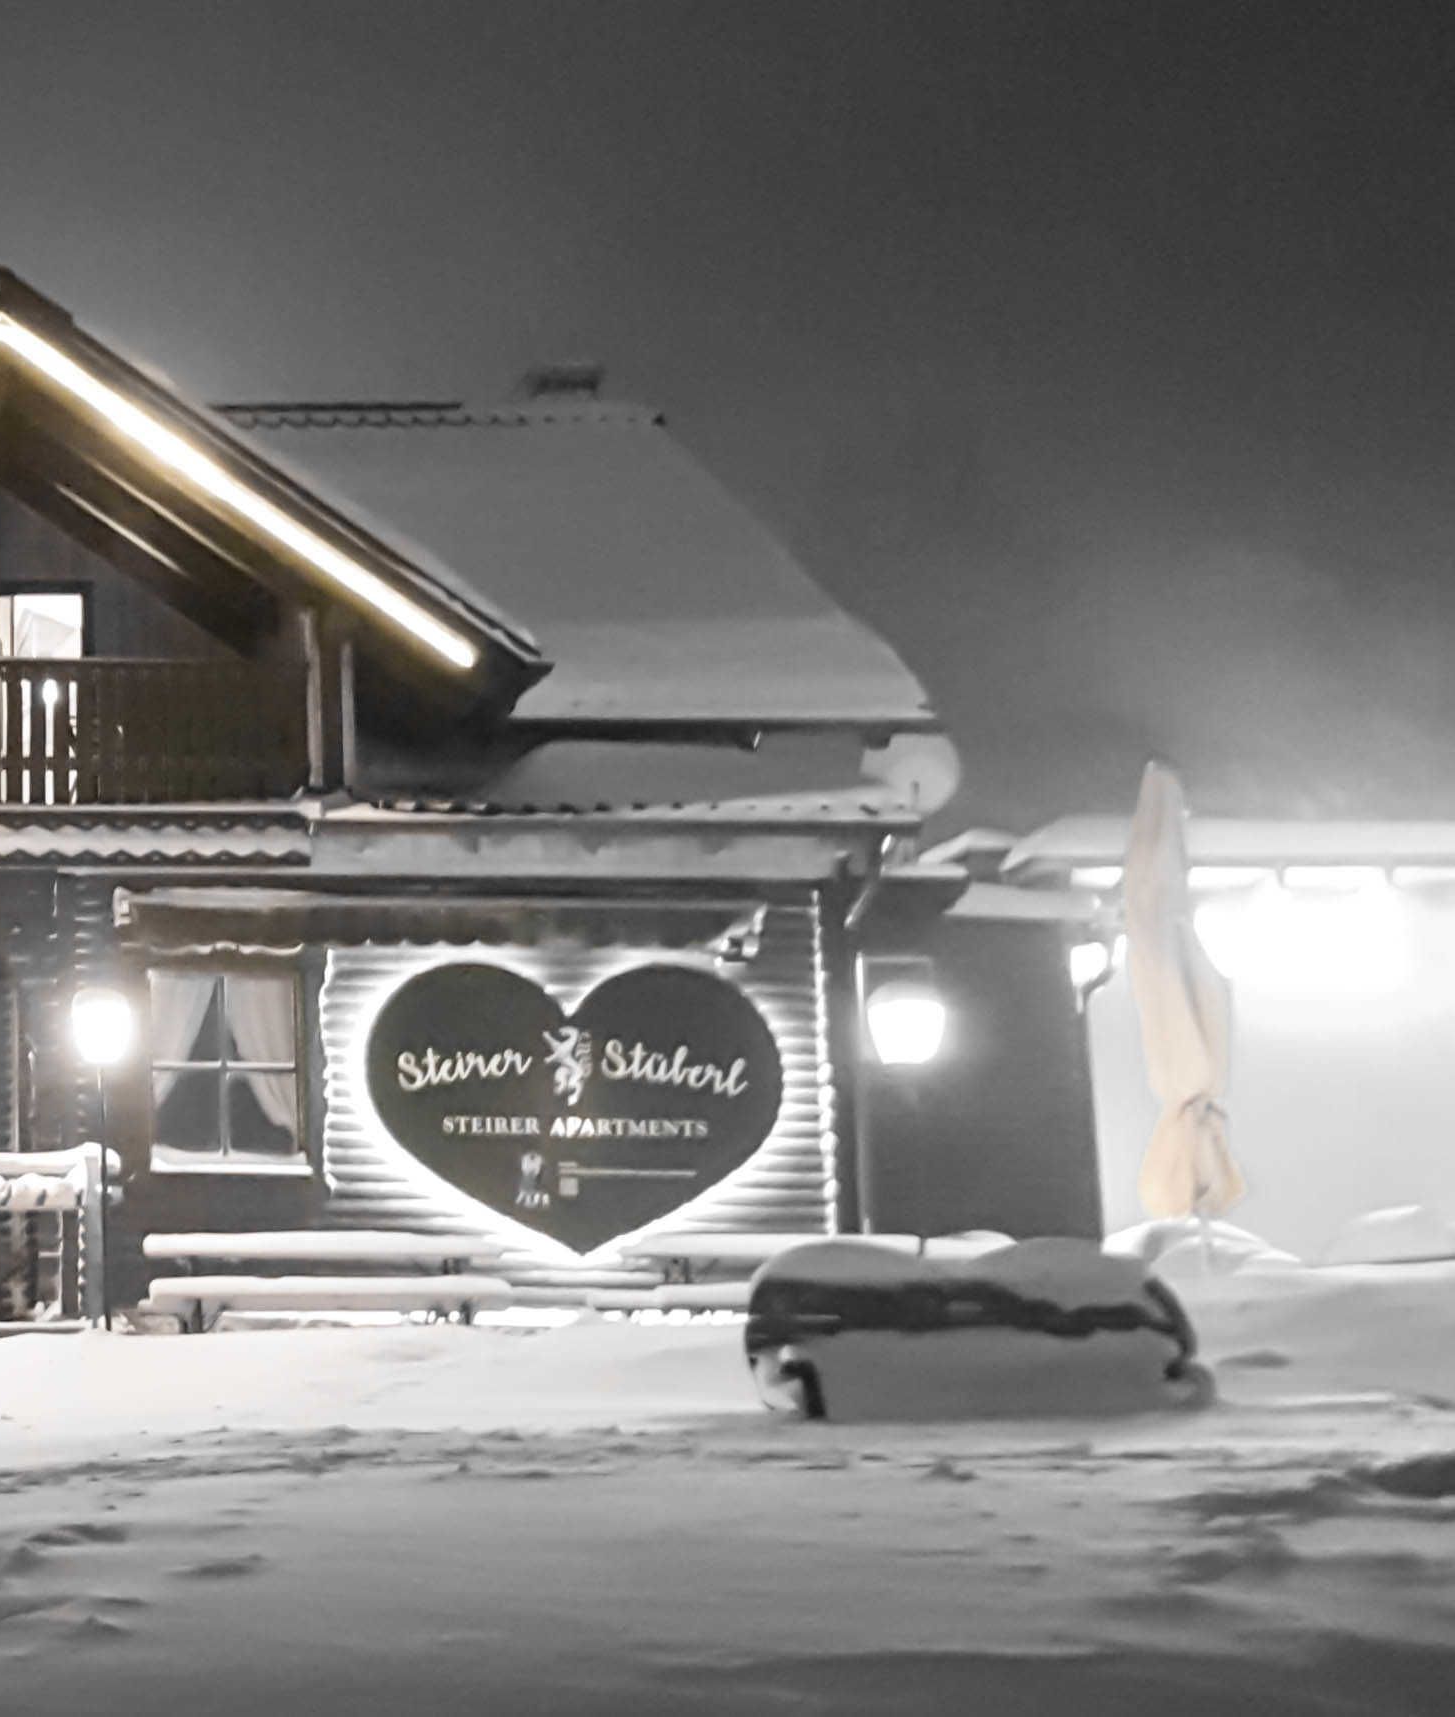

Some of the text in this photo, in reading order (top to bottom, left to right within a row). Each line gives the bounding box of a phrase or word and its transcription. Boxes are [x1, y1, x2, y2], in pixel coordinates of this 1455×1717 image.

[397, 1047, 533, 1091] Steirer
[442, 1115, 709, 1138] STEIRER APARTMENTS
